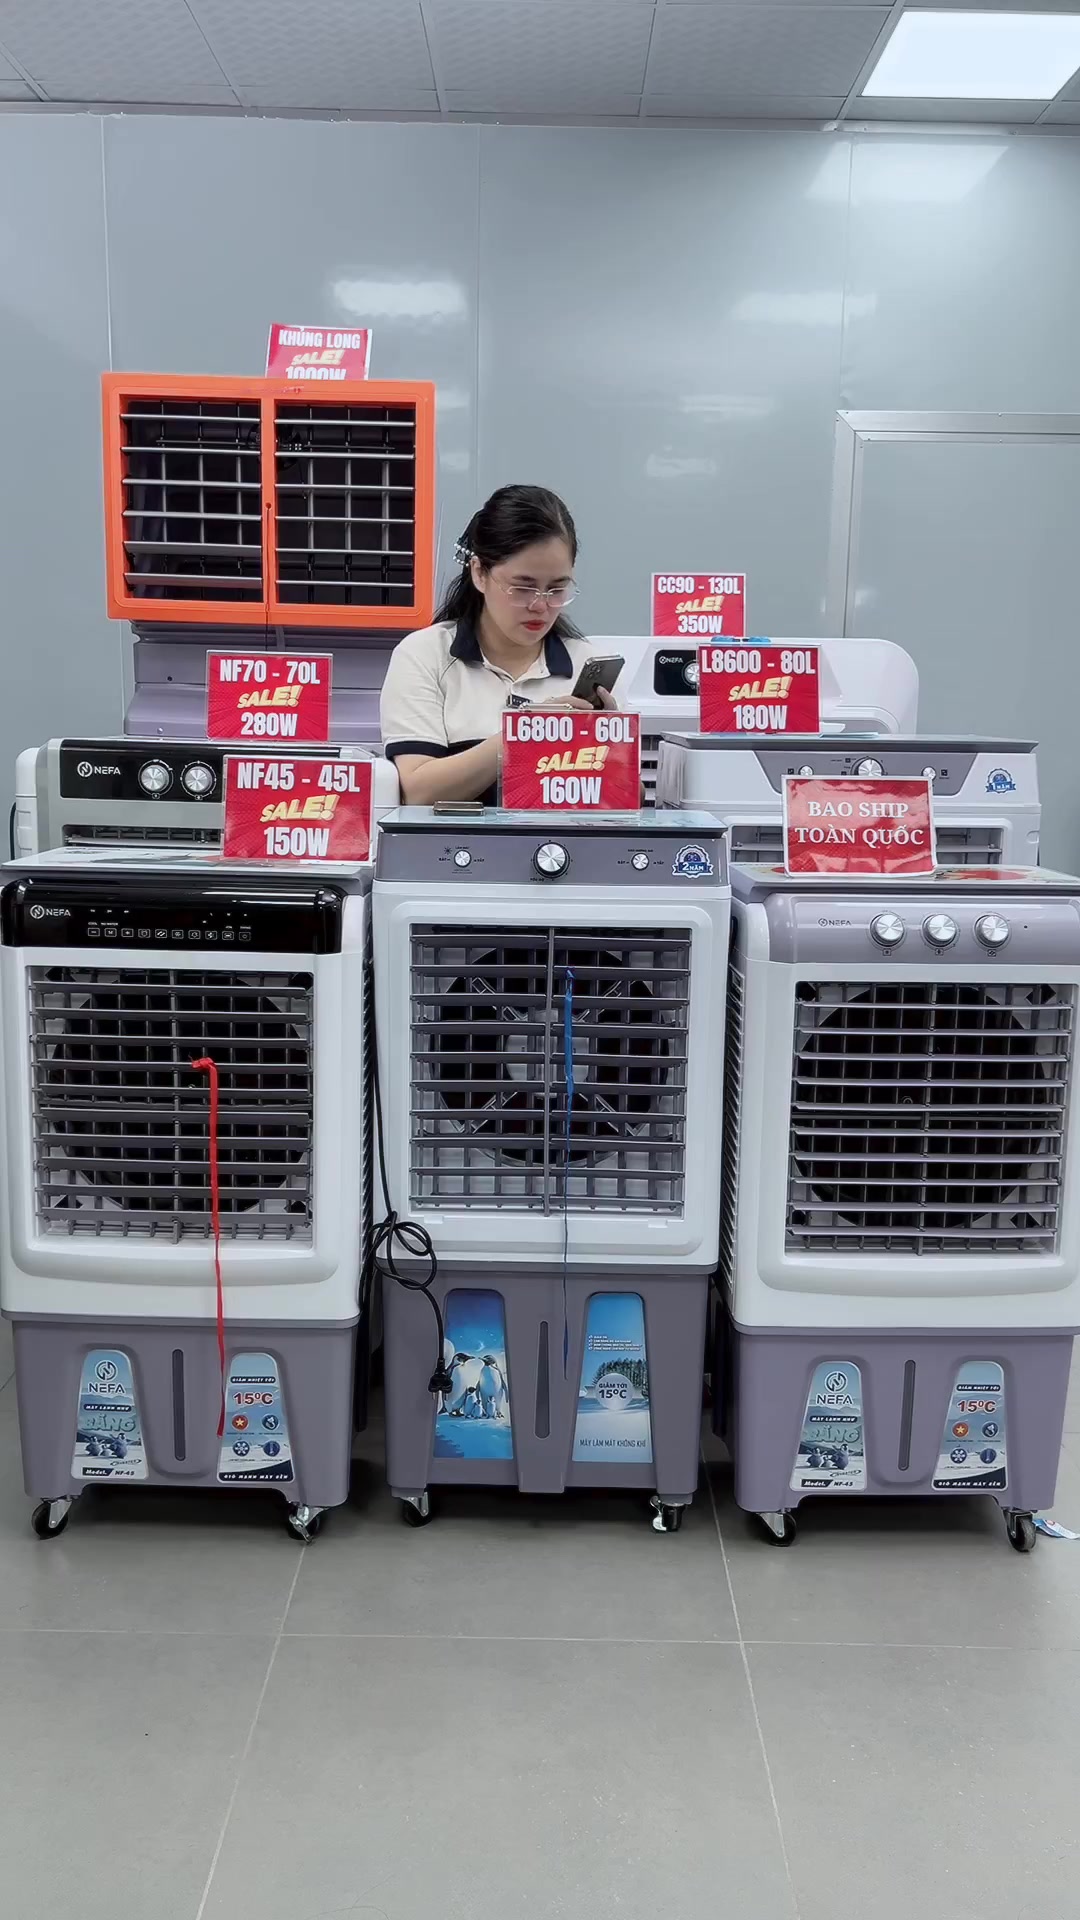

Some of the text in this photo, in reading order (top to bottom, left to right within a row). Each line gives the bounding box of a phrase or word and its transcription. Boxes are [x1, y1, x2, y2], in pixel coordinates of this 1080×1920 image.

[326, 333, 361, 349] LONG
[291, 350, 345, 365] SALE!
[286, 366, 346, 379] 1000W
[657, 576, 695, 594] CC90
[708, 577, 741, 594] 130L
[675, 595, 724, 613] SALE!
[678, 615, 722, 633] 350W
[220, 659, 266, 682] NF70
[286, 661, 320, 684] 70L
[701, 650, 761, 673] L8600
[780, 651, 816, 674] 80L
[237, 685, 303, 708] SALE!
[728, 676, 792, 701] SALE!
[241, 712, 298, 736] 280W
[733, 704, 788, 729] 180W
[506, 715, 573, 742] L6800
[595, 717, 634, 743] 60L
[94, 766, 121, 775] NEFA
[535, 746, 610, 774] SALE!
[237, 763, 294, 790] NF45
[317, 765, 360, 792] 45L
[540, 776, 601, 804] 160W
[260, 794, 340, 822] SALE!
[808, 802, 909, 818] BAO SHIP
[264, 827, 330, 856] 150W
[795, 824, 924, 849] TOÀN QUỐC
[682, 862, 689, 871] 2
[46, 909, 71, 917] NEFA
[88, 1383, 125, 1393] NEFA
[817, 1394, 853, 1405] NEFA
